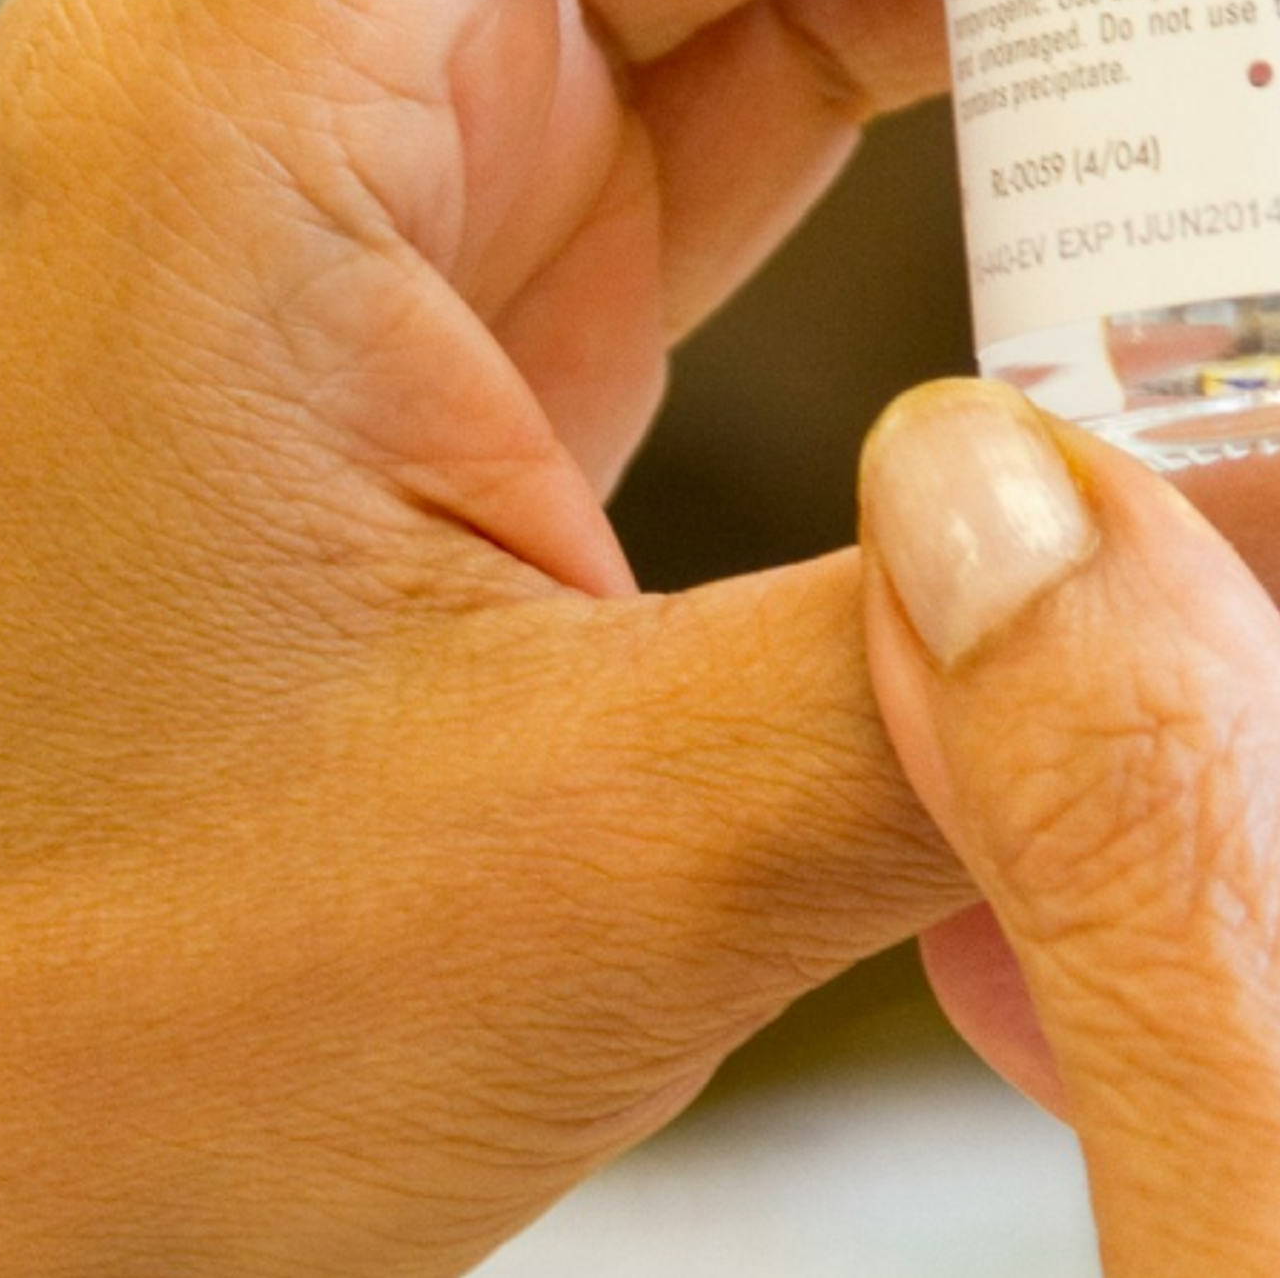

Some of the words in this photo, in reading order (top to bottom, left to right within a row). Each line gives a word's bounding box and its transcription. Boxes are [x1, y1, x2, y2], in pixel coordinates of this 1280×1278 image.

[1100, 12, 1135, 44] Do
[1148, 6, 1193, 35] not
[1207, 0, 1258, 28] use
[1011, 59, 1132, 113] precipitate.
[1074, 134, 1161, 184] (4/04)
[1057, 220, 1114, 260] EXP
